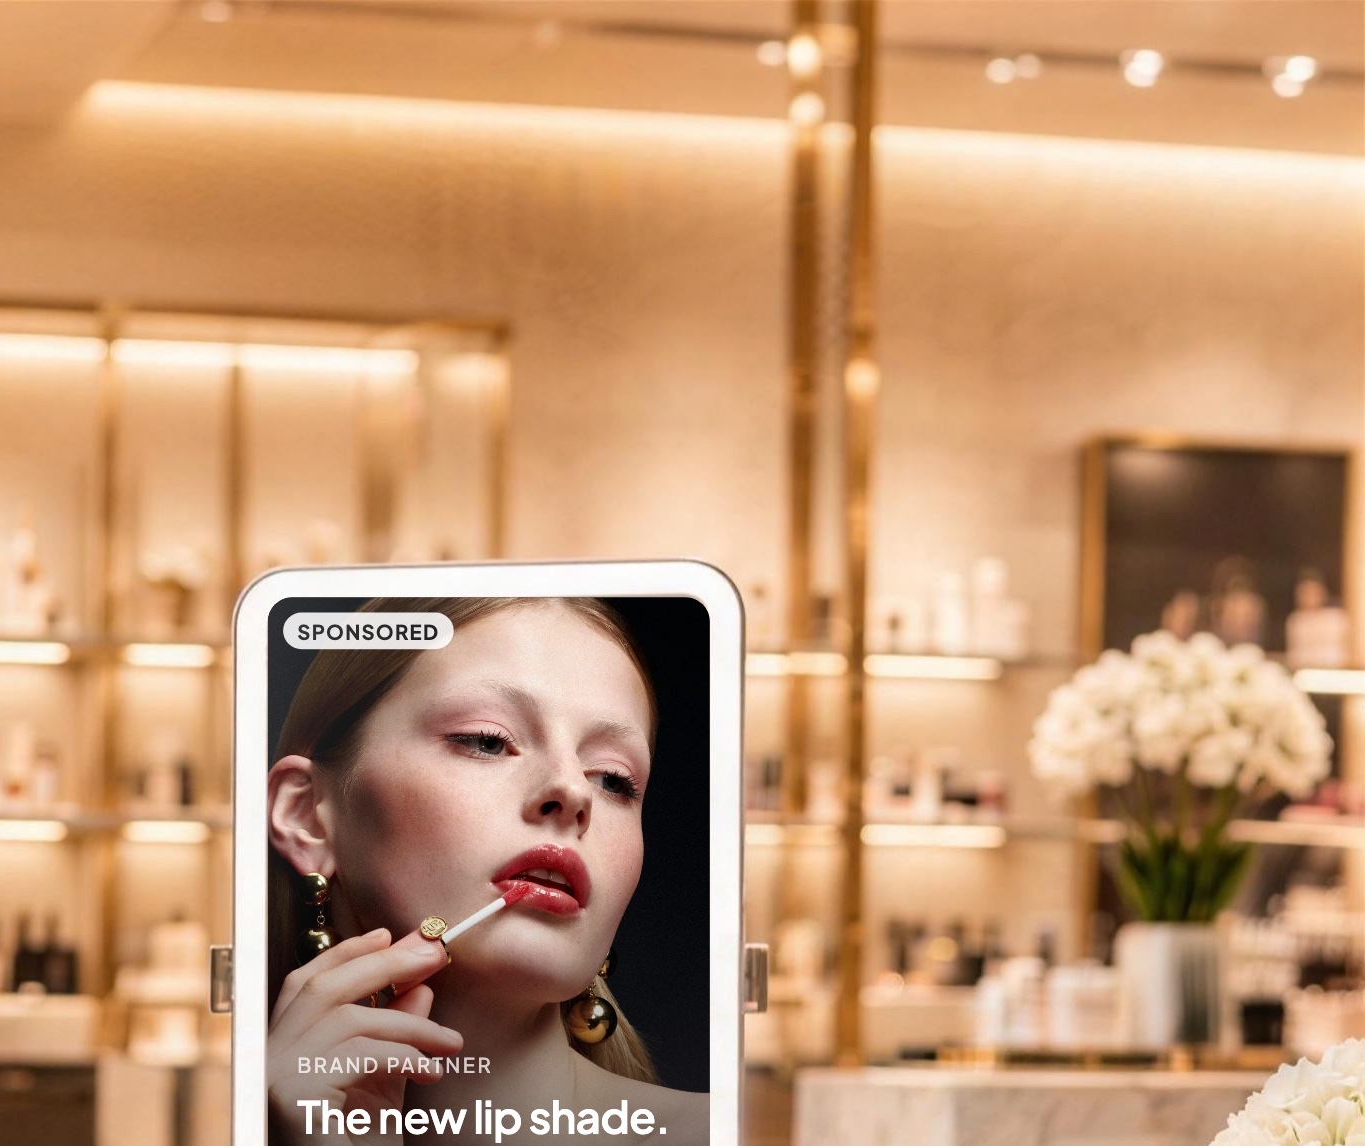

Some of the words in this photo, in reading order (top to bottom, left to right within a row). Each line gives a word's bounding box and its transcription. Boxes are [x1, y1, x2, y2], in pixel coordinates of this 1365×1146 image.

[297, 624, 438, 641] SPONSORED
[298, 1057, 379, 1074] BRAND
[387, 1057, 491, 1074] PARTNER
[297, 1099, 371, 1135] The
[380, 1108, 467, 1135] new
[475, 1099, 522, 1144] lip
[529, 1099, 667, 1135] shade.
